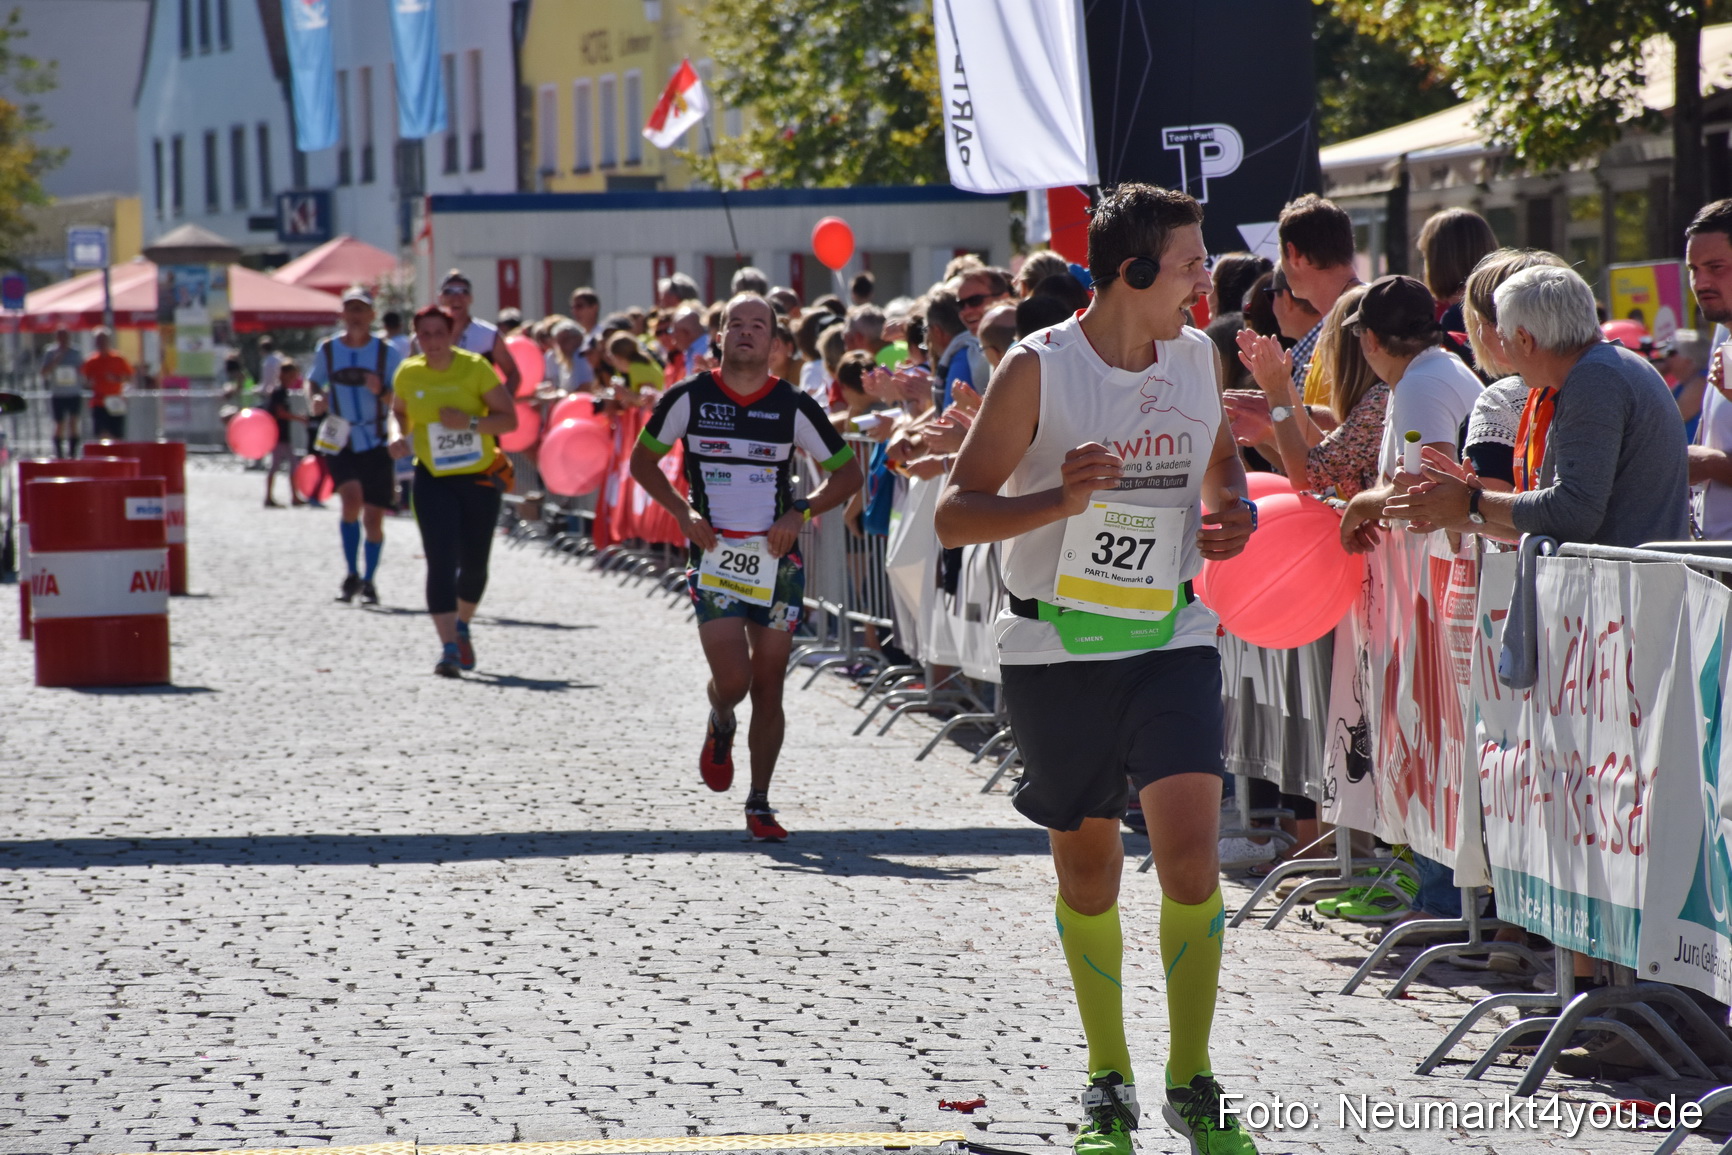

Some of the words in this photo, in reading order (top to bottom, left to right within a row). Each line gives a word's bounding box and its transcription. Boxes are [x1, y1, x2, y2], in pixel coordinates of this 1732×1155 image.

[437, 433, 474, 449] 2549
[1145, 461, 1152, 471] &
[1155, 459, 1191, 470] akademie
[1134, 479, 1145, 488] for
[1147, 478, 1160, 487] the
[1163, 477, 1184, 486] future
[1104, 511, 1156, 529] BOCK
[1091, 531, 1156, 570] 327
[719, 550, 760, 575] 298
[1084, 567, 1110, 579] PARTL
[1111, 573, 1143, 583] Neumarkt
[719, 579, 753, 596] Michael
[1674, 935, 1700, 967] Jura
